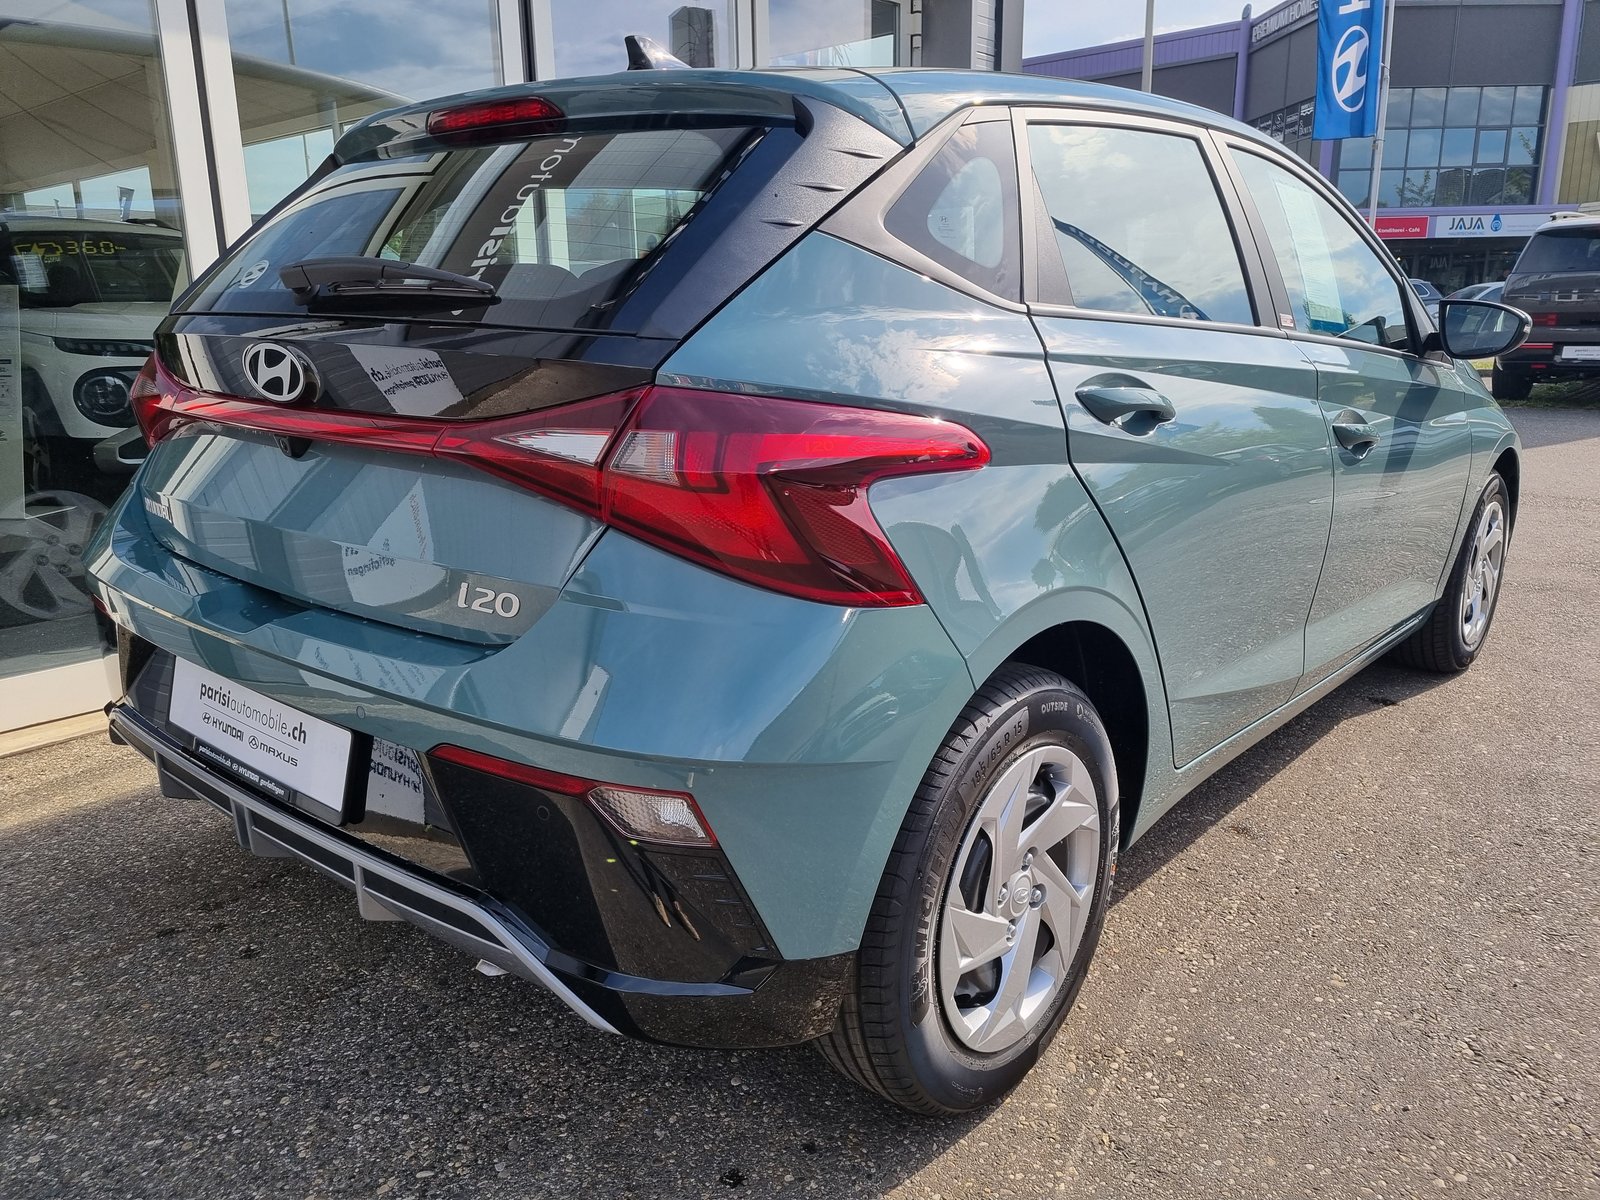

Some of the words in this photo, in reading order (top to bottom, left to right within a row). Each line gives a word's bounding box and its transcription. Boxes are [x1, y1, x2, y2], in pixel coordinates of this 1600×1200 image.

[1252, 9, 1290, 42] PREMIUM
[1449, 217, 1485, 230] JAJA
[66, 240, 115, 255] 360
[457, 582, 521, 618] i20
[199, 683, 307, 744] parisiautomobile.ch
[1041, 701, 1069, 714] OUTSIDE
[211, 717, 245, 742] HYUNDAI
[259, 742, 299, 767] MAXUS
[1003, 732, 1011, 747] R
[1013, 720, 1023, 738] 15
[238, 765, 260, 783] HYUNDAI
